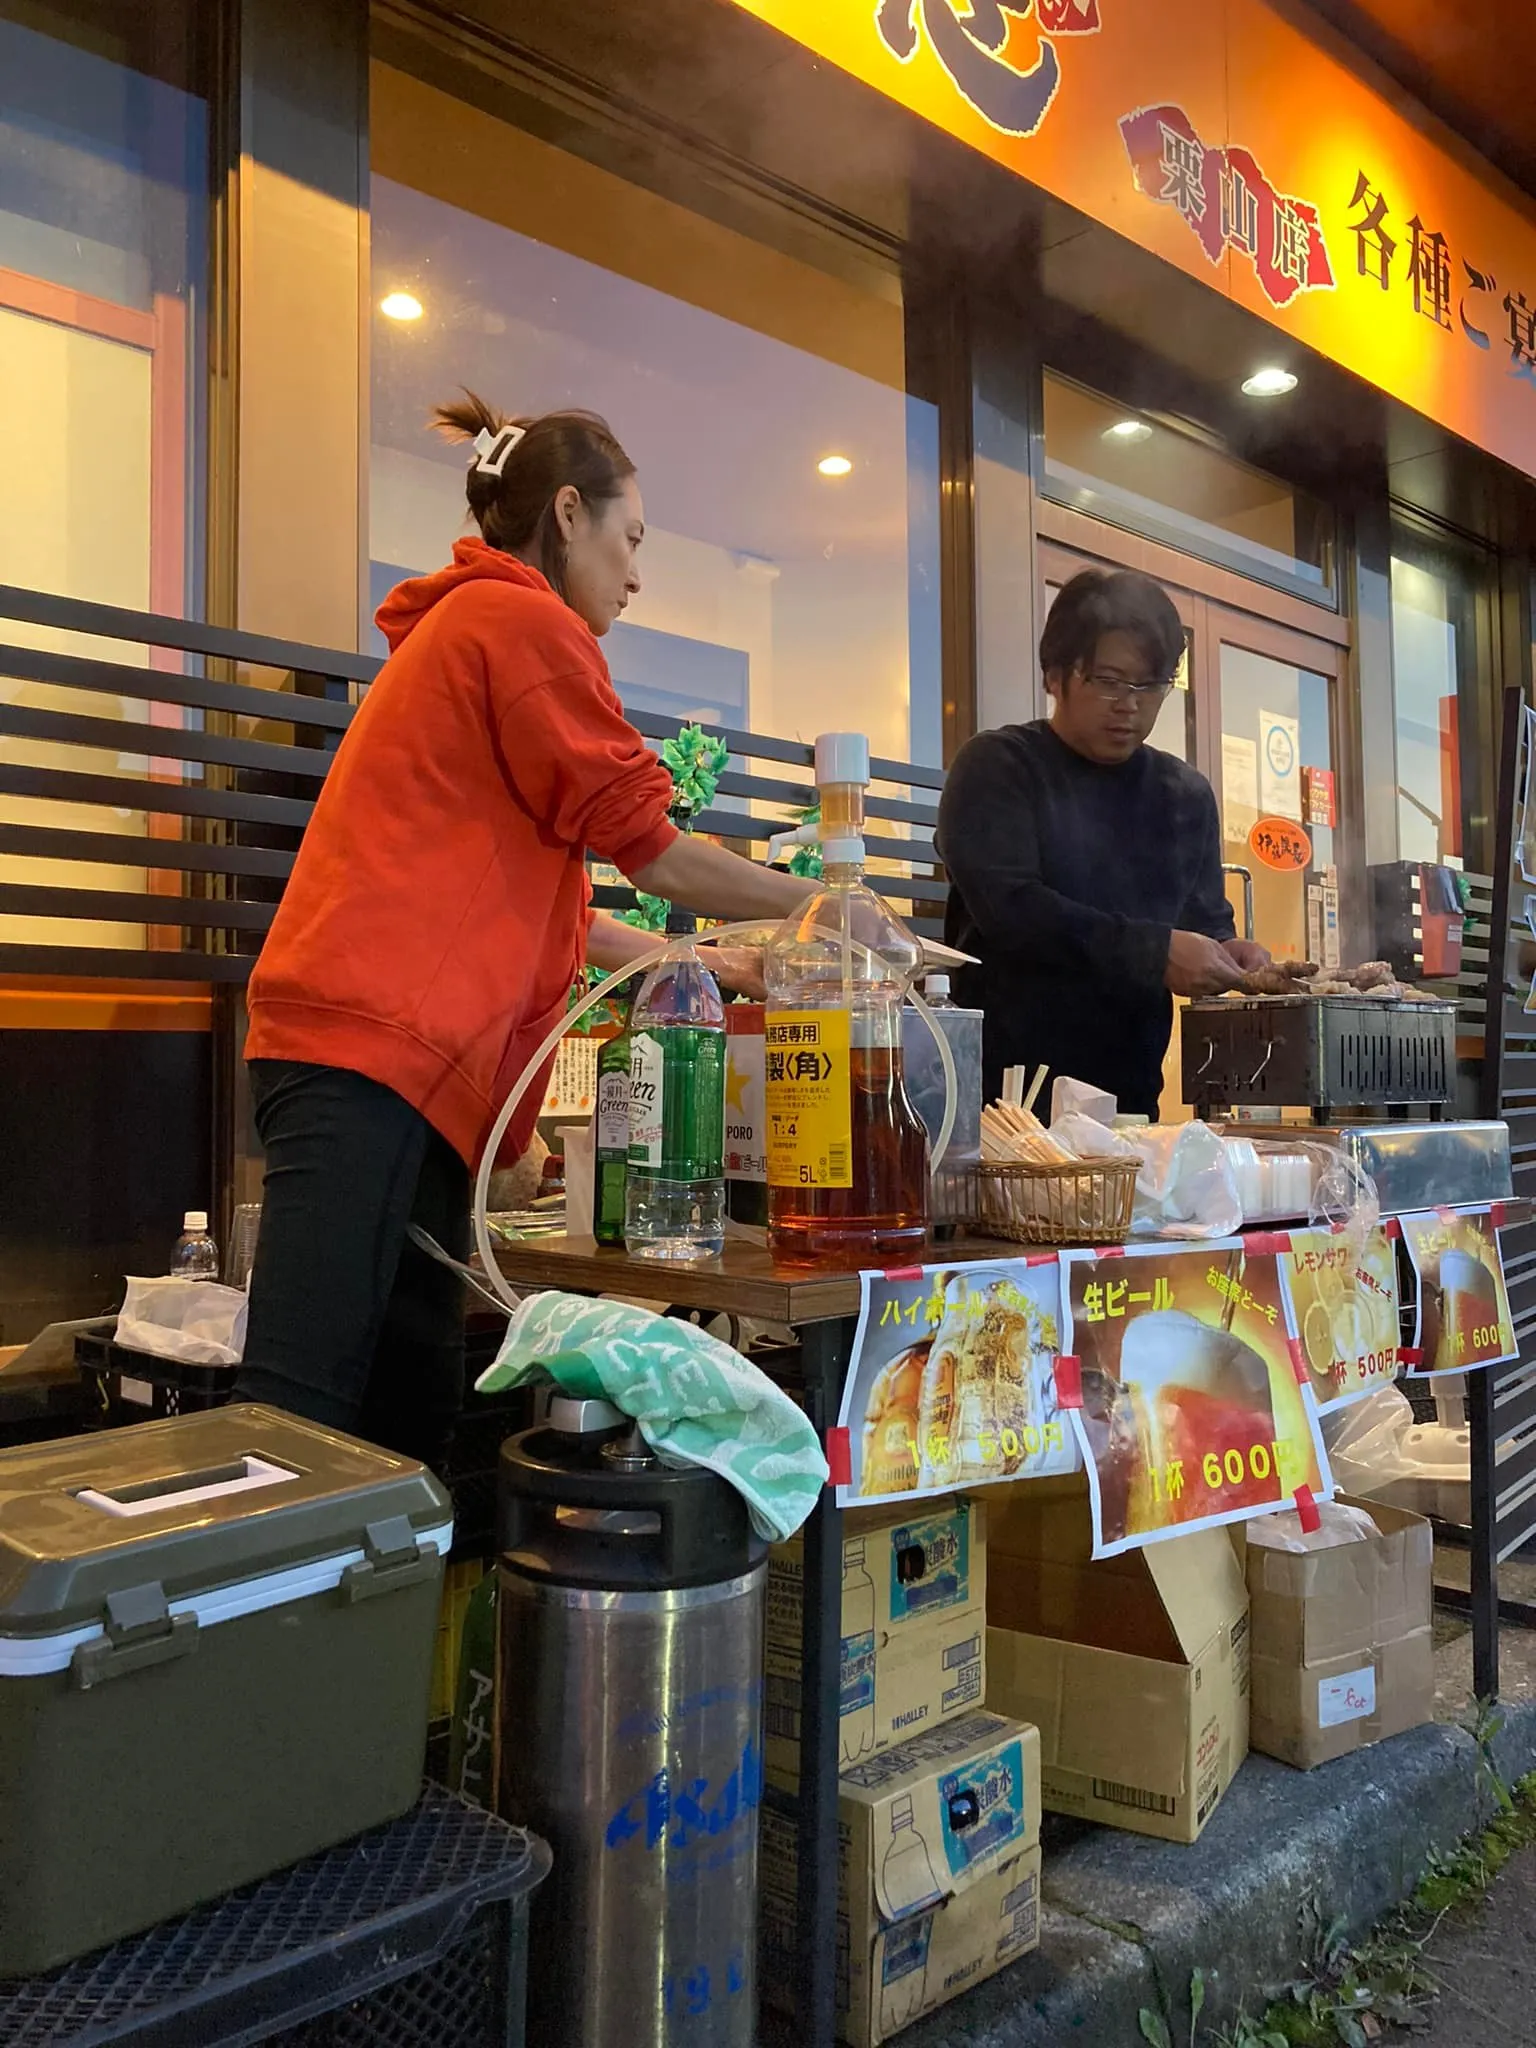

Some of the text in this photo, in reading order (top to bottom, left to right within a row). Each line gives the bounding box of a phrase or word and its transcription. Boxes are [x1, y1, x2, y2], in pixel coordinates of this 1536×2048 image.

[1158, 119, 1311, 287] 栗山店
[766, 1025, 818, 1044] 務店専用
[766, 1051, 833, 1082] 製〈角〉
[600, 1097, 629, 1114] Green
[726, 1125, 753, 1141] PORO
[799, 1164, 818, 1184] 5L
[1293, 1246, 1349, 1276] レモンサワ
[879, 1289, 988, 1328] ハイボール
[1083, 1277, 1175, 1323] 生ビール
[1206, 1265, 1279, 1326] お座席どーぞ
[1357, 1347, 1394, 1379] 500円
[1202, 1440, 1299, 1489] 600円
